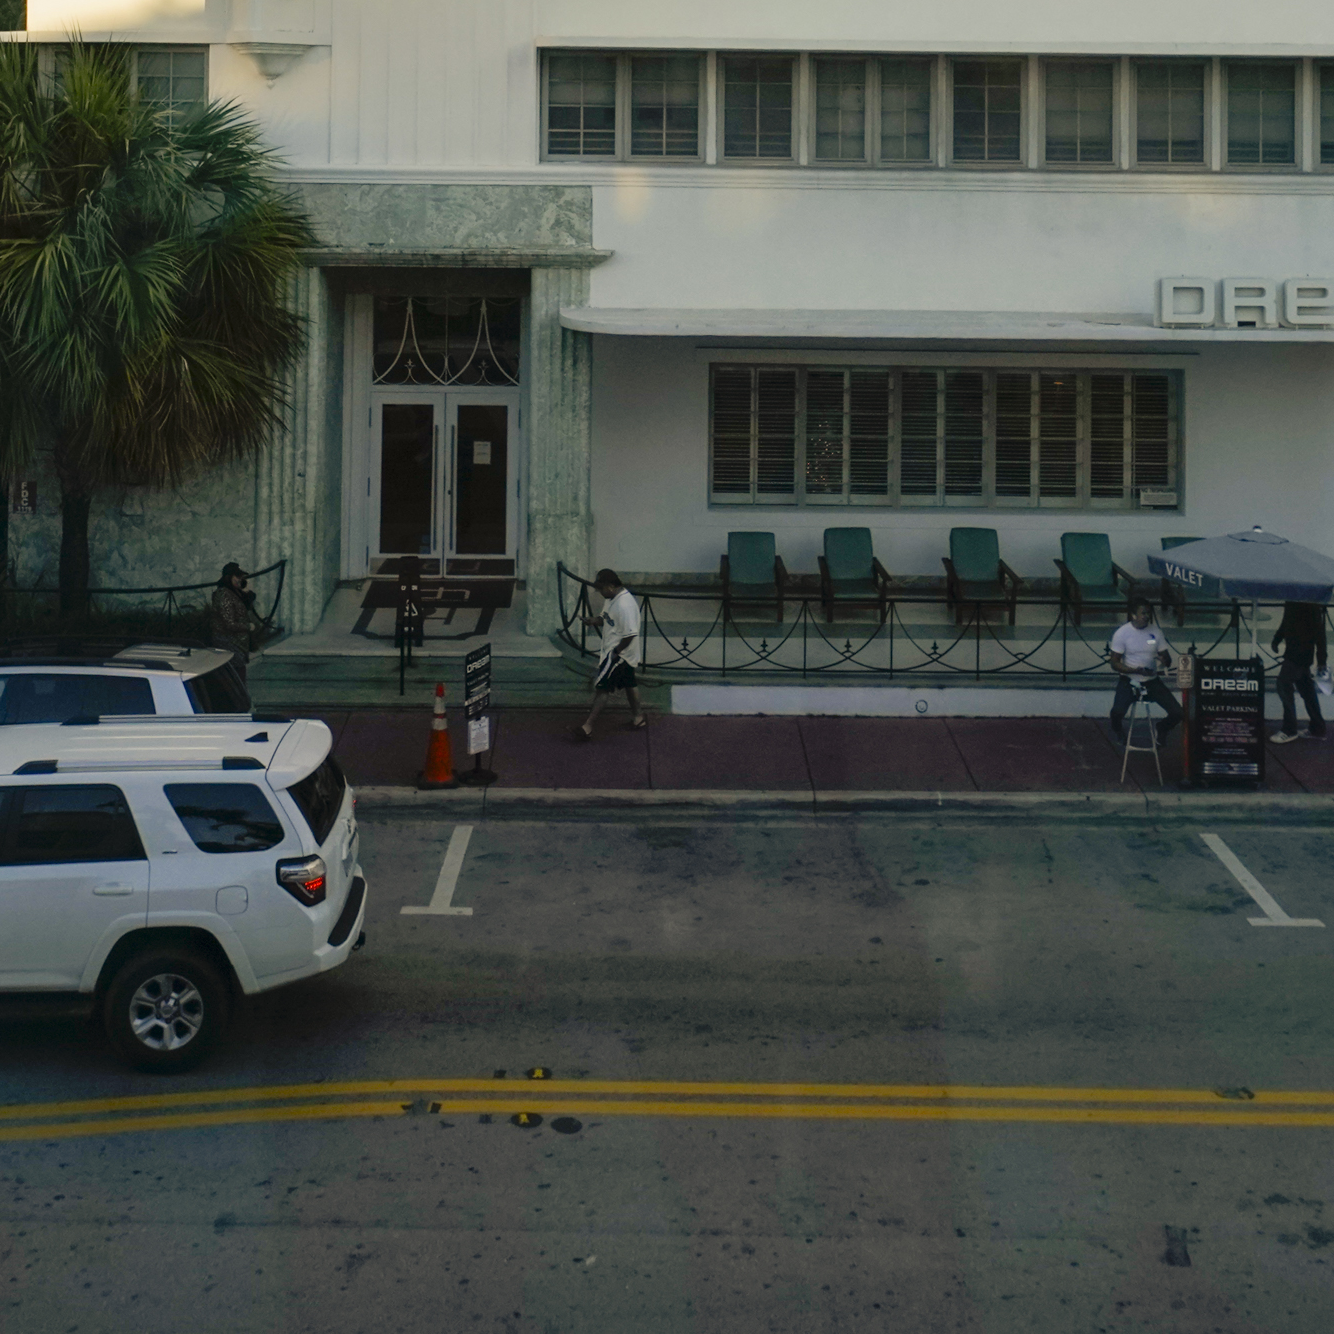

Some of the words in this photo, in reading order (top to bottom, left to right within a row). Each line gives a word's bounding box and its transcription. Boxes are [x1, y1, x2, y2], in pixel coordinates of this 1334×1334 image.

[20, 481, 30, 507] FDC
[1165, 562, 1204, 587] VALET
[1201, 704, 1225, 713] VALET
[1226, 704, 1258, 714] PARKING
